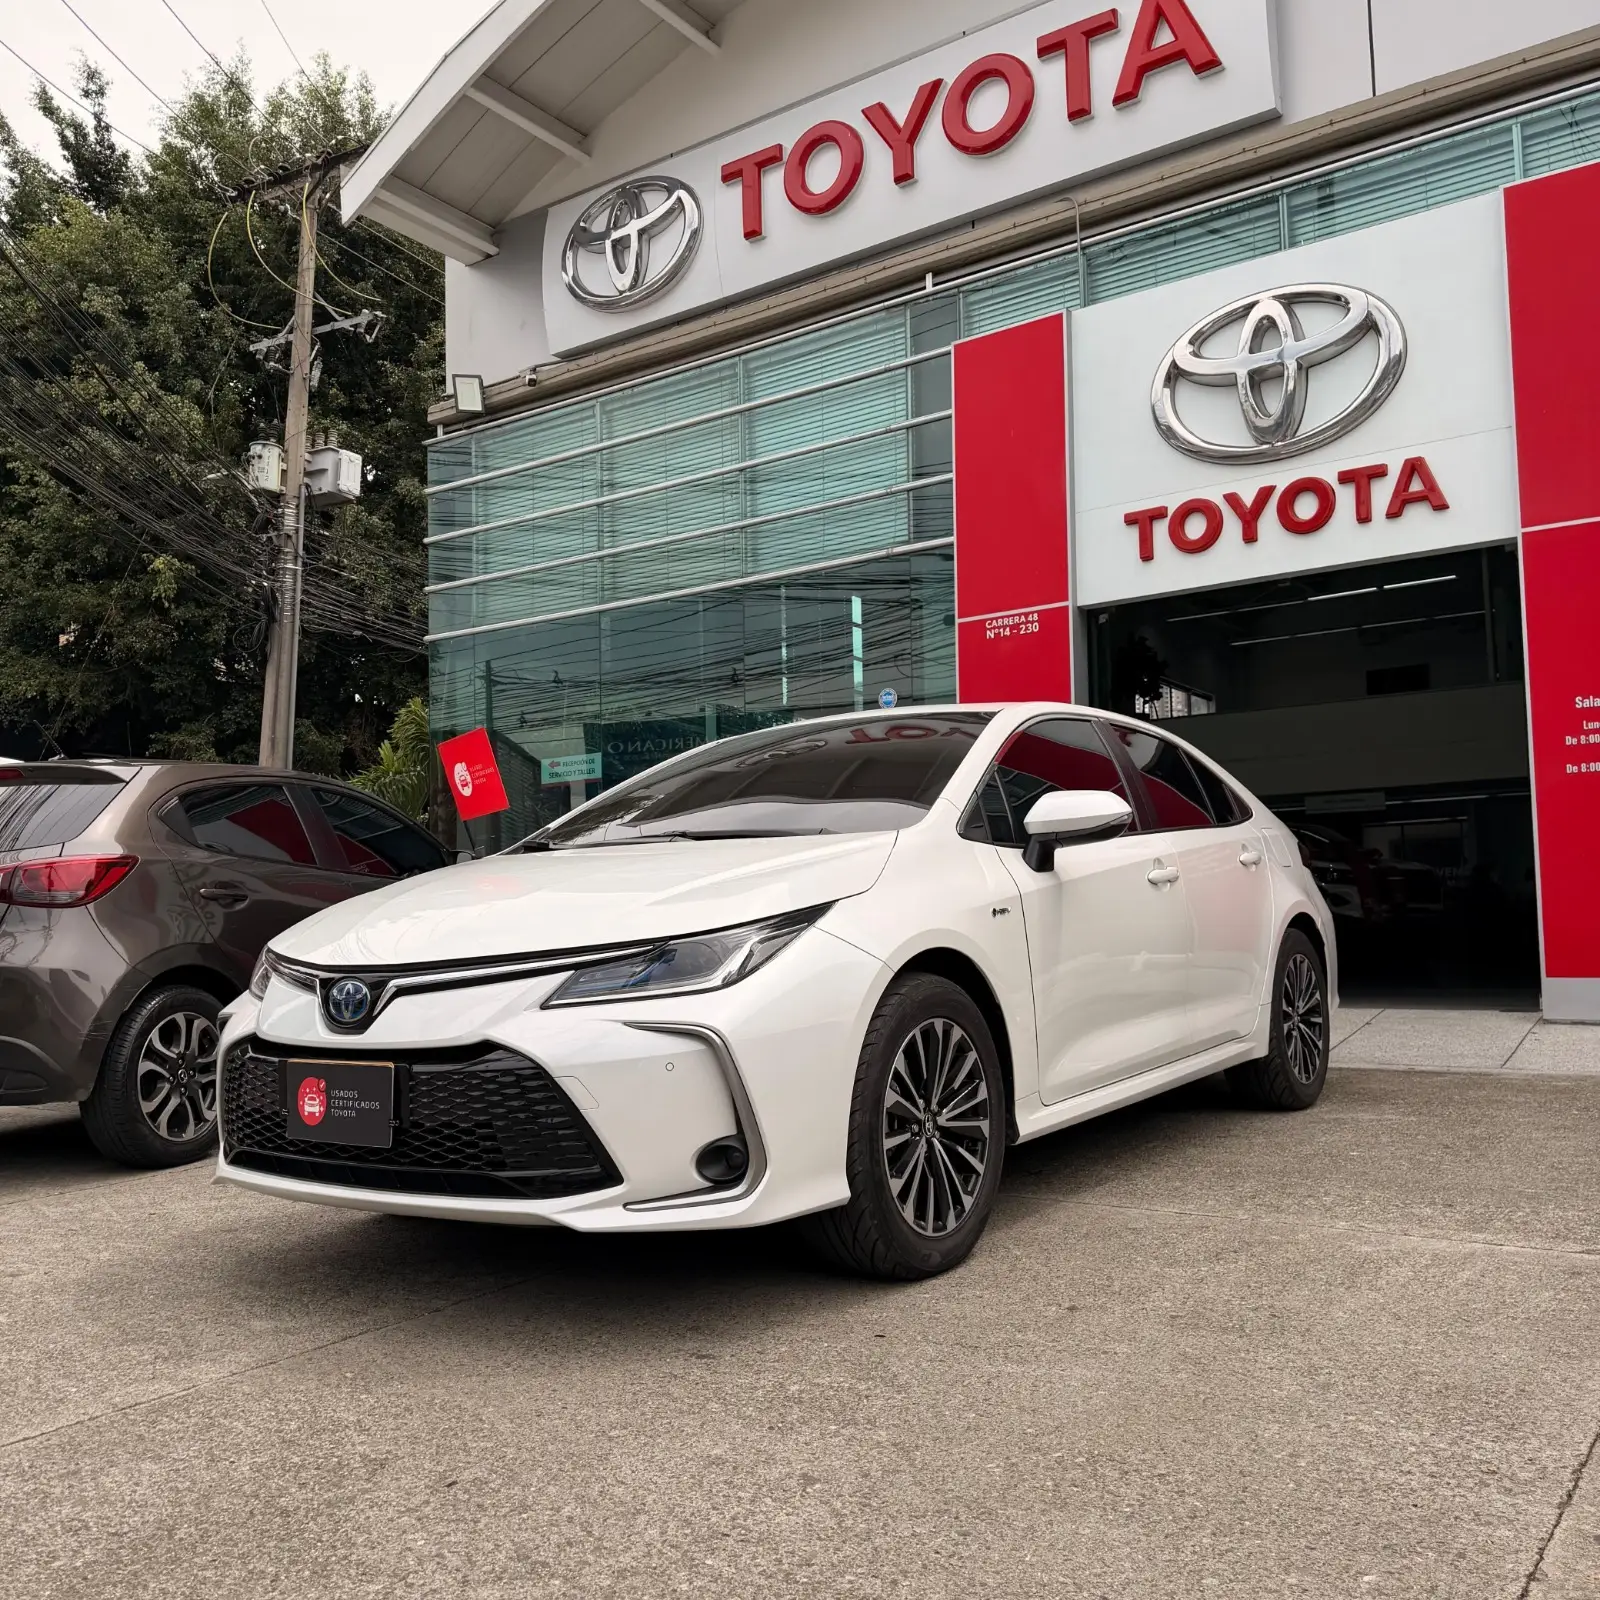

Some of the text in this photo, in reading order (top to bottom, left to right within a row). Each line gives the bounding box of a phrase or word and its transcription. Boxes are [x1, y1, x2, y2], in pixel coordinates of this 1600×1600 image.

[721, 0, 1223, 241] TOYOTA
[1124, 456, 1450, 561] TOYOTA
[985, 613, 1039, 628] CARRERA 48
[1019, 622, 1039, 634] 230
[1575, 695, 1600, 708] Sala
[1583, 720, 1600, 730] Lun
[1565, 733, 1600, 746] De 8:00
[548, 770, 572, 779] SERVICIO
[577, 767, 596, 775] TALLER
[1566, 762, 1600, 774] De 8:00
[330, 1089, 358, 1099] USADOS
[330, 1099, 380, 1110] CERTIFICADOS
[330, 1108, 356, 1118] TOYOTA
